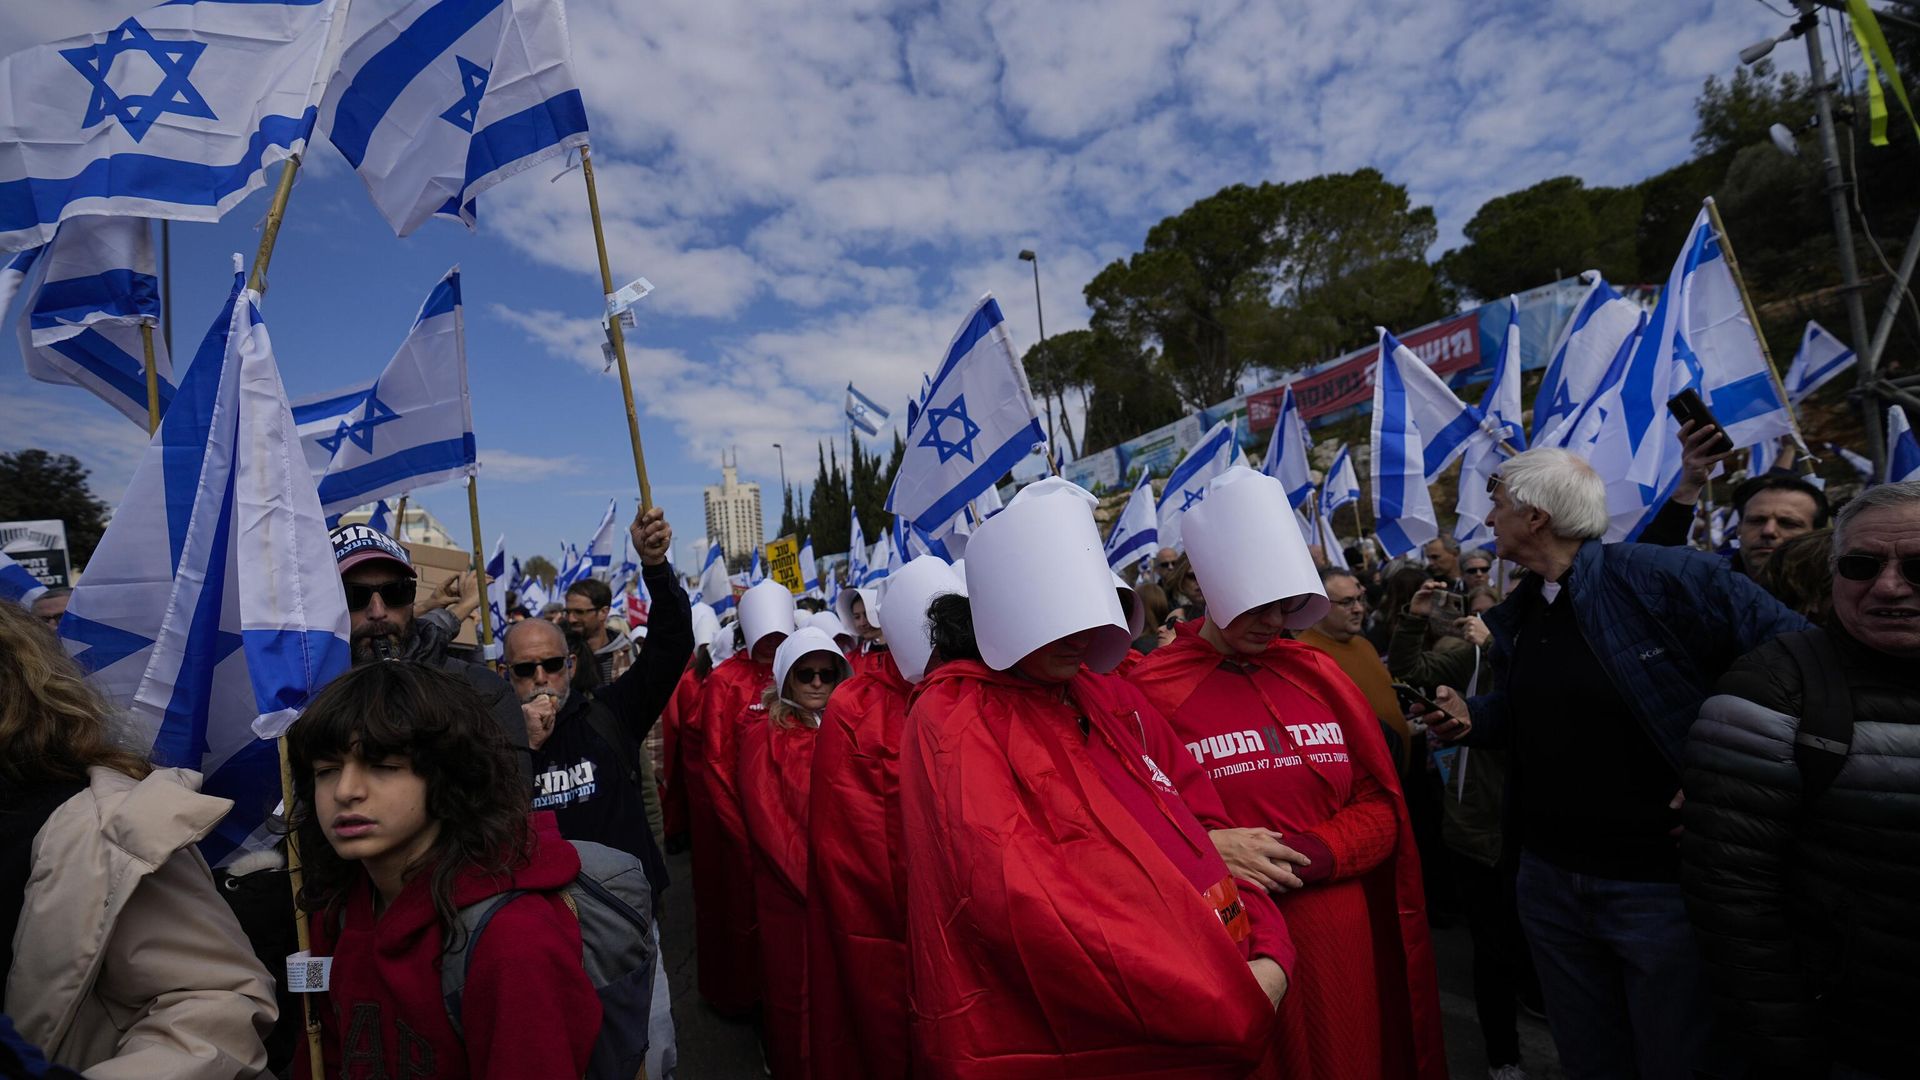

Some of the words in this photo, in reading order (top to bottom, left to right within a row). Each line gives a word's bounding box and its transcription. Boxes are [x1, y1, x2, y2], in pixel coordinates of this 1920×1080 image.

[331, 525, 408, 562] נאמני
[336, 539, 373, 559] העצמ
[1214, 761, 1256, 779] במשמרת
[1257, 758, 1270, 770] לא
[1273, 755, 1302, 769] הנשים,
[534, 761, 594, 795] נאמני
[533, 792, 563, 808] העצמ
